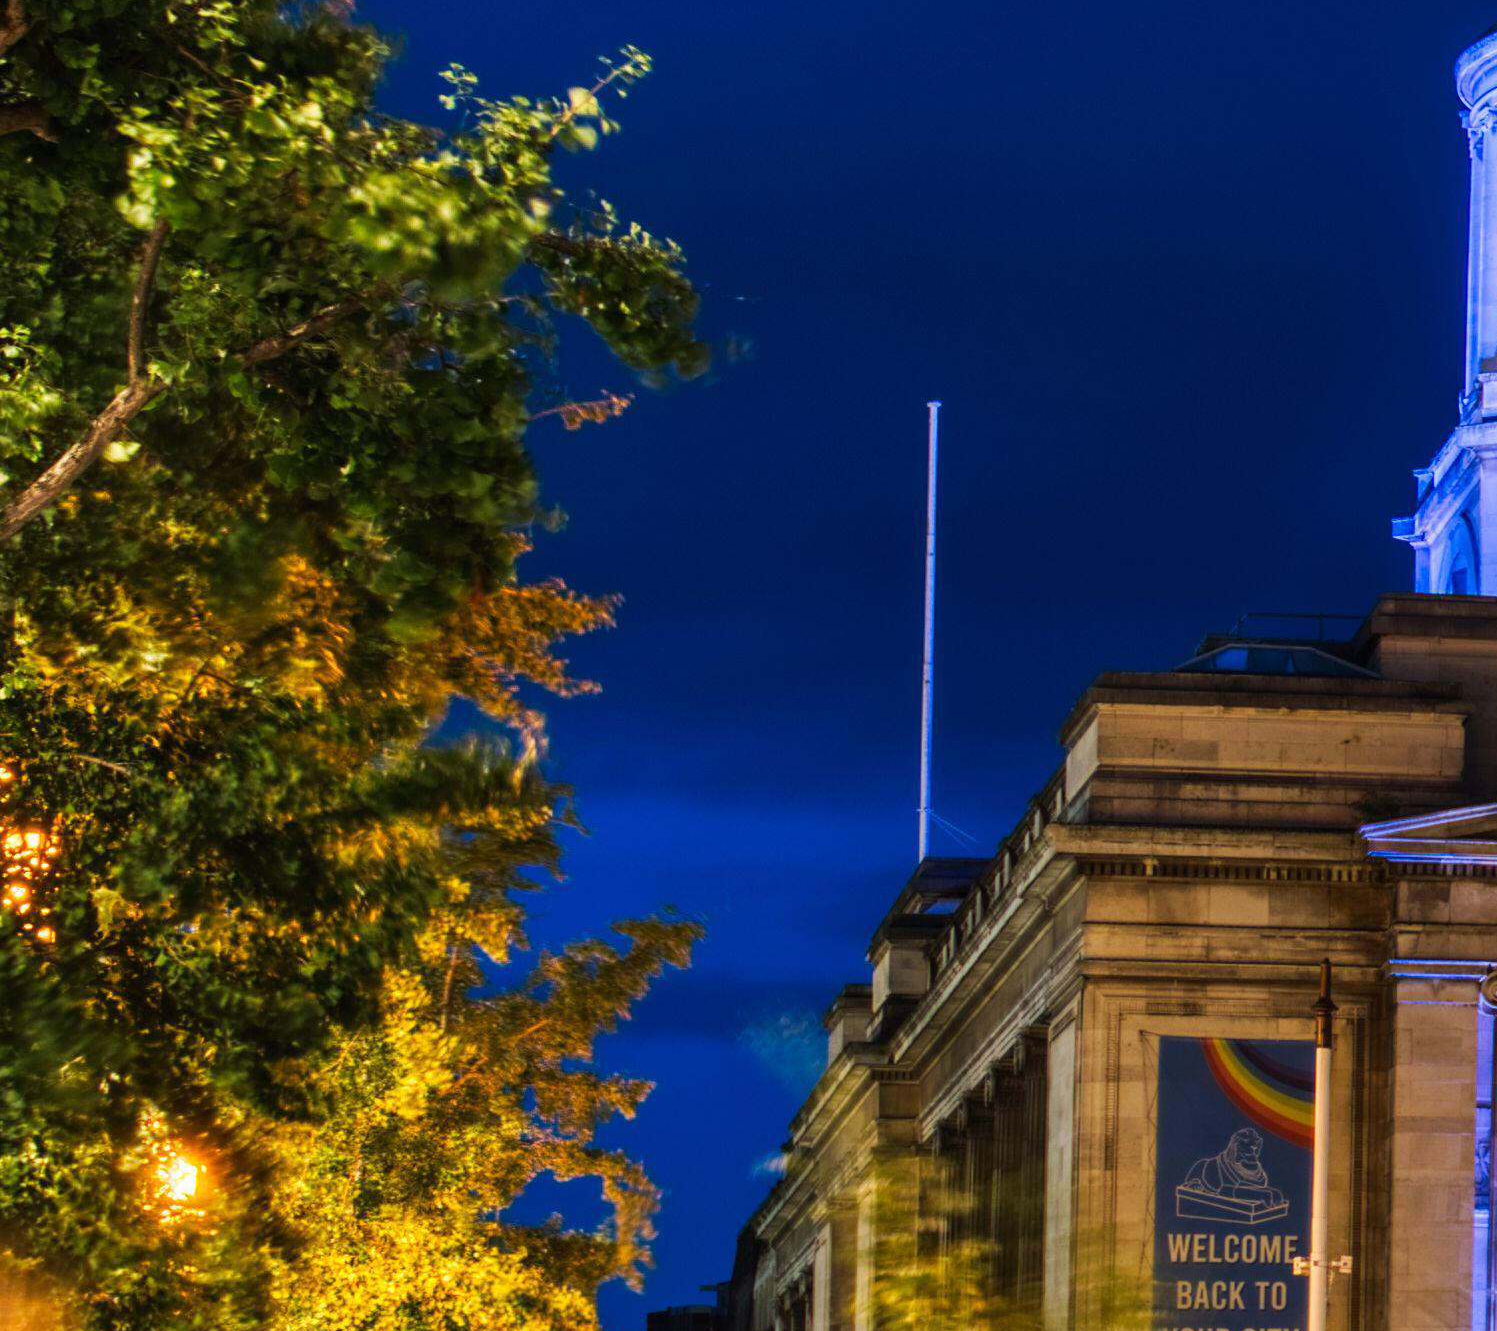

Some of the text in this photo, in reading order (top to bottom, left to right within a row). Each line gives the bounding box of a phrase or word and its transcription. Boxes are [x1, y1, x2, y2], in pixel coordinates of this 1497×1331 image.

[1167, 1233, 1299, 1264] WELCOME
[1177, 1280, 1288, 1311] BACK TO
